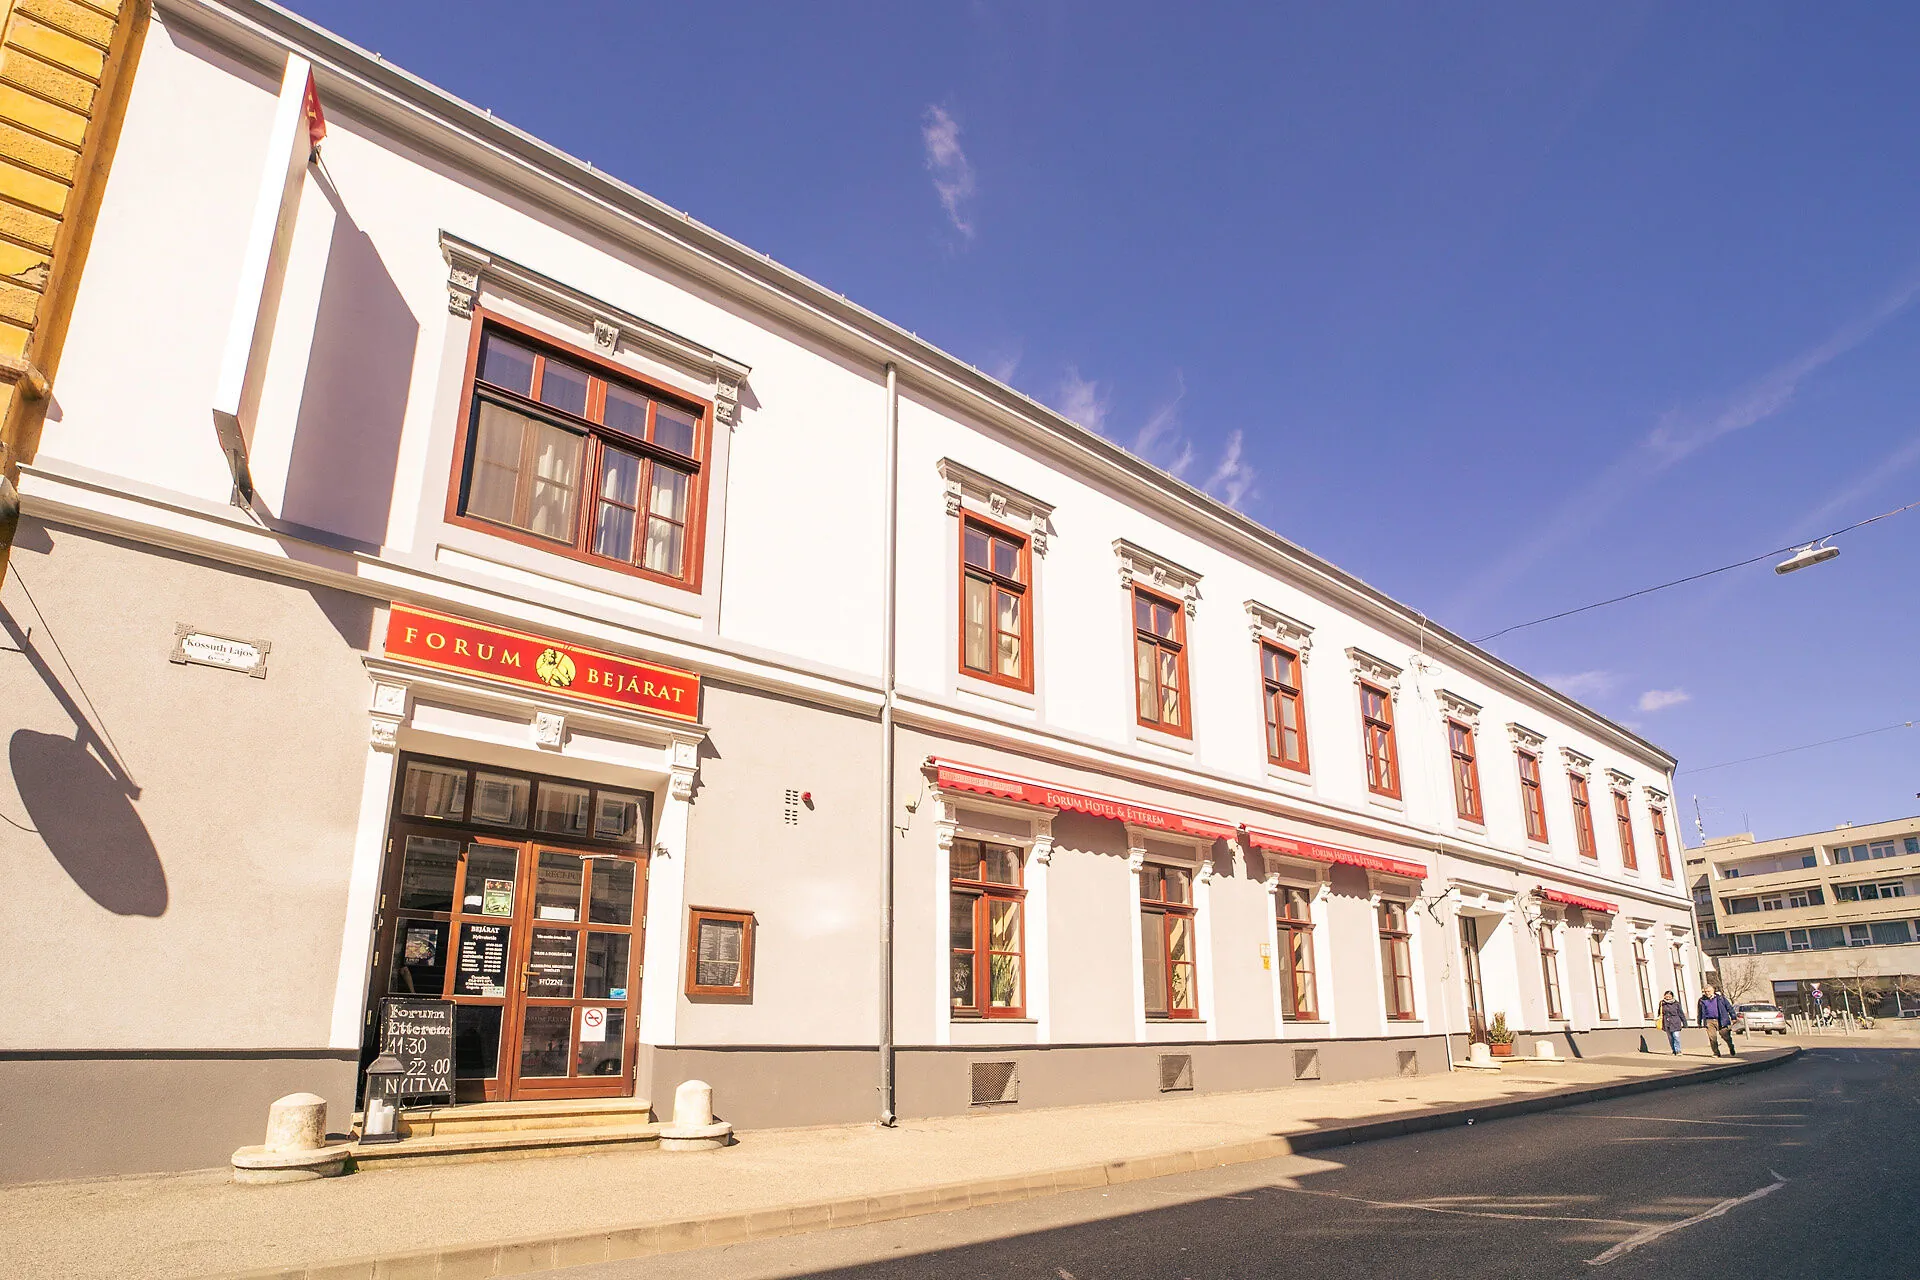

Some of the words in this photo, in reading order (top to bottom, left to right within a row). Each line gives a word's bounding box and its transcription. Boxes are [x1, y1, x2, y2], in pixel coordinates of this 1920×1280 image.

[187, 639, 227, 654] Kossuth
[229, 646, 254, 658] Lajos
[403, 626, 522, 668] FORUM
[587, 667, 686, 704] BEJÁRAT
[1047, 792, 1082, 809] FORUM
[1085, 799, 1116, 815] HOTEL
[1117, 806, 1125, 818] &
[470, 925, 500, 934] BEJÁRAT
[389, 1003, 445, 1019] Forum
[389, 1036, 427, 1055] 11:30
[385, 1076, 449, 1094] NYITVA
